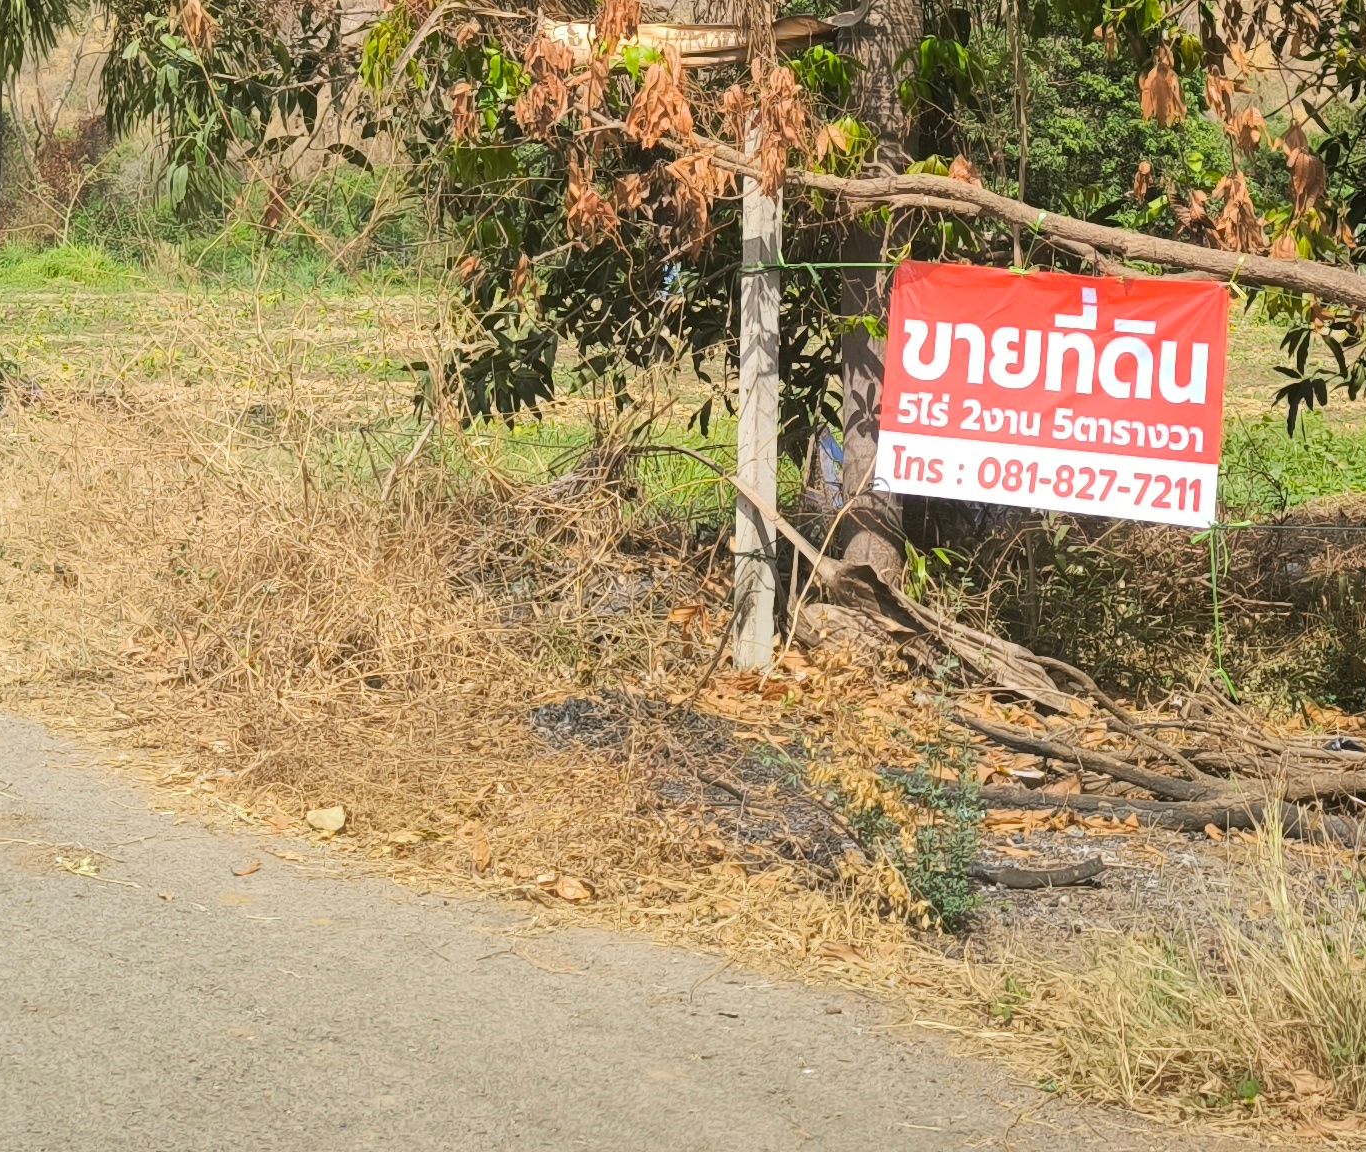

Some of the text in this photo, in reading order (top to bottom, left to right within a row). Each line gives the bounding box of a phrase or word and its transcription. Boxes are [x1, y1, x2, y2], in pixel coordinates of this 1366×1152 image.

[901, 287, 1210, 405] ขายที่ดิน
[896, 391, 1204, 453] 5ไร่ 2งาน 5ตารางวา
[892, 445, 1203, 513] โทร : 081-827-7211
